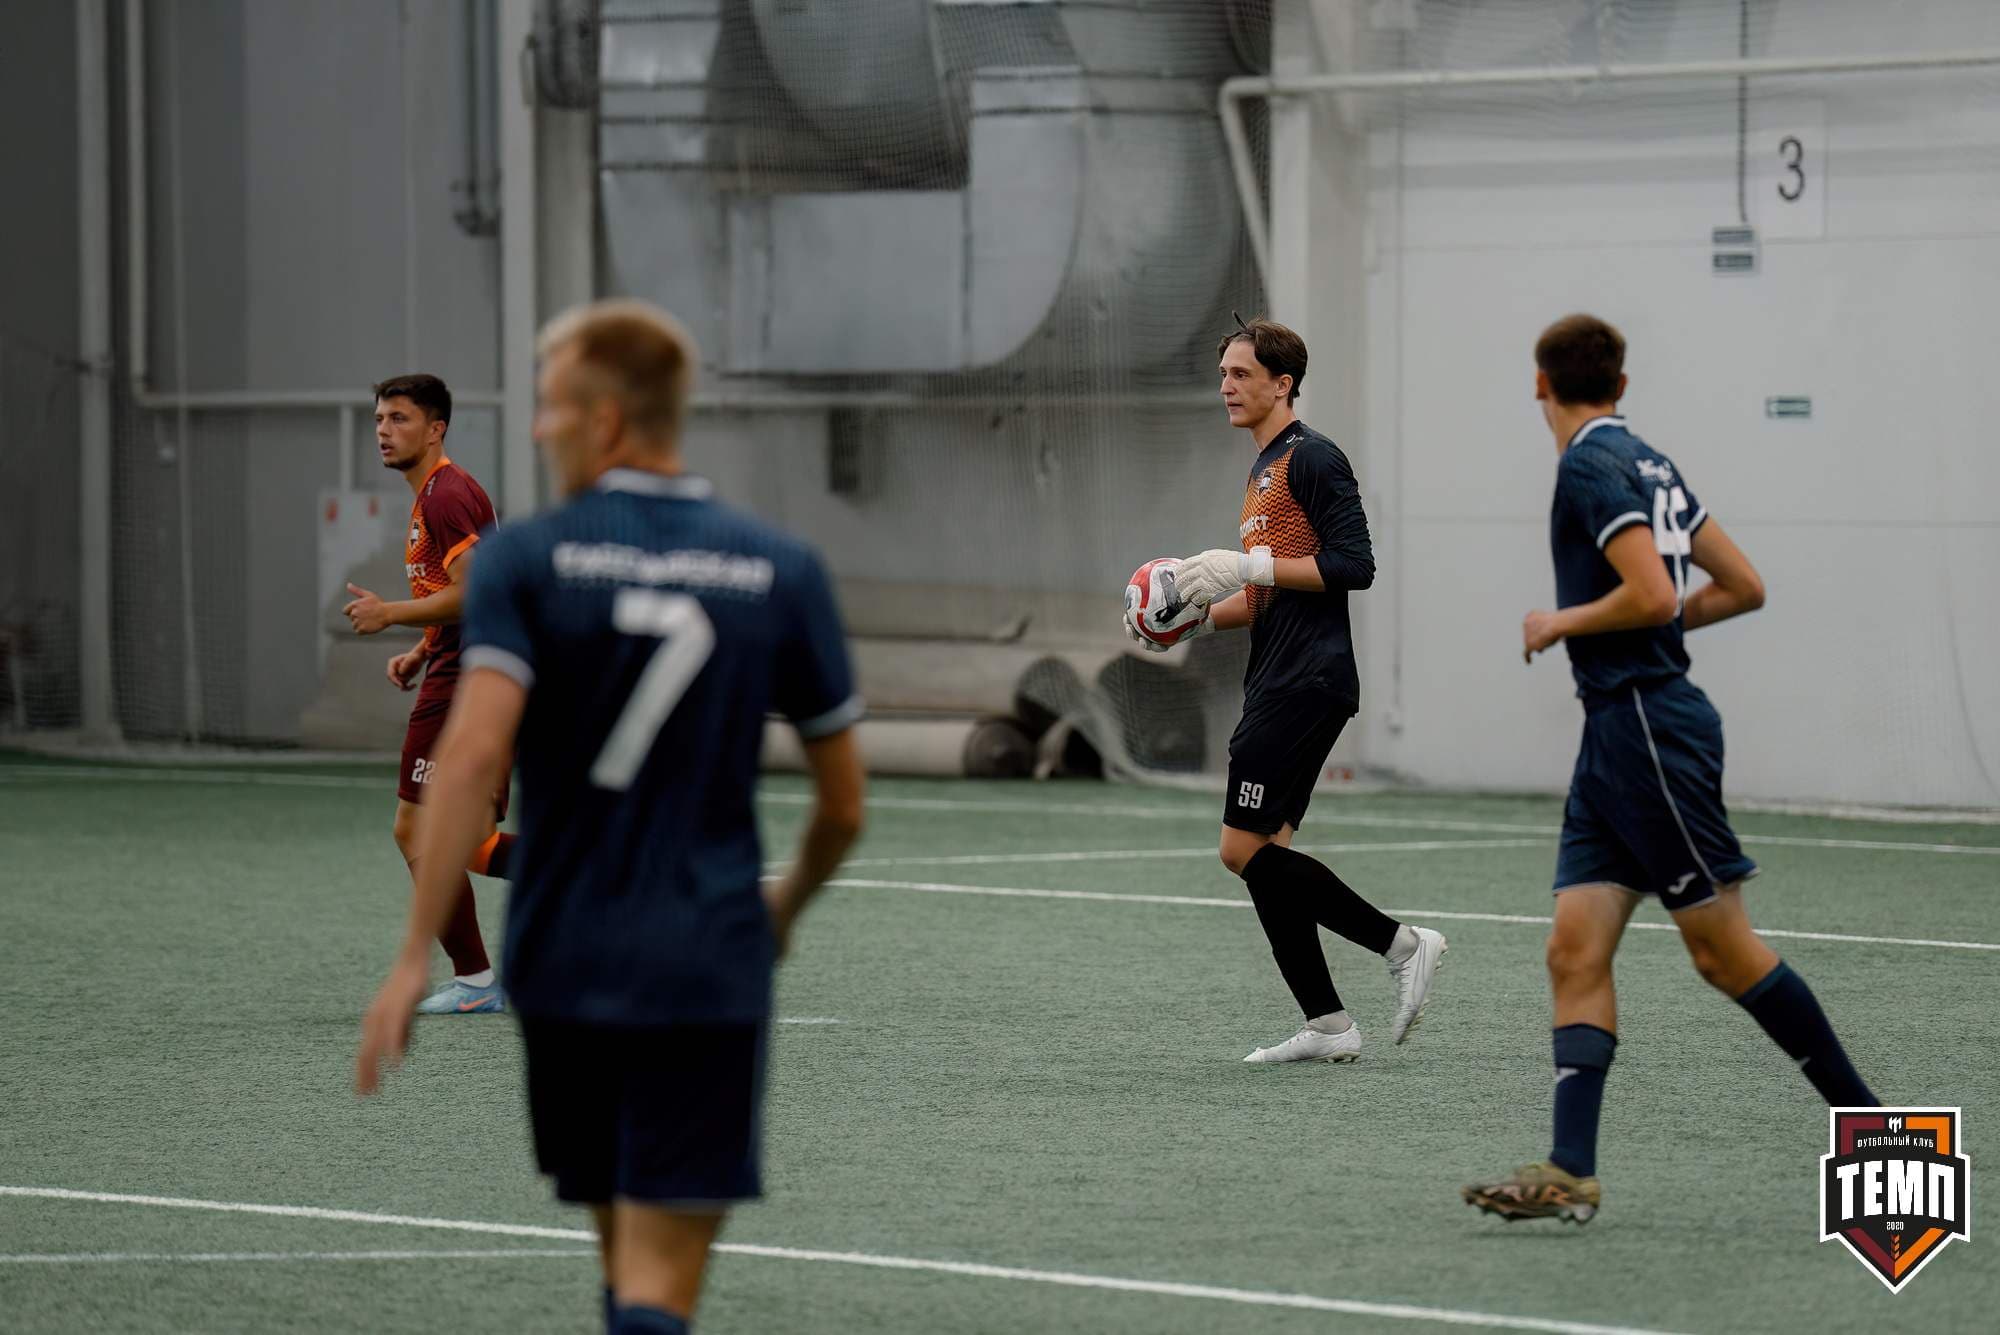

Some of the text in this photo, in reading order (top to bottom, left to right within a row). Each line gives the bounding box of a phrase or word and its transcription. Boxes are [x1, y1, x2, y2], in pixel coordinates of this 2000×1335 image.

[1778, 137, 1805, 203] 3
[588, 586, 717, 791] 7
[1238, 780, 1265, 809] 59
